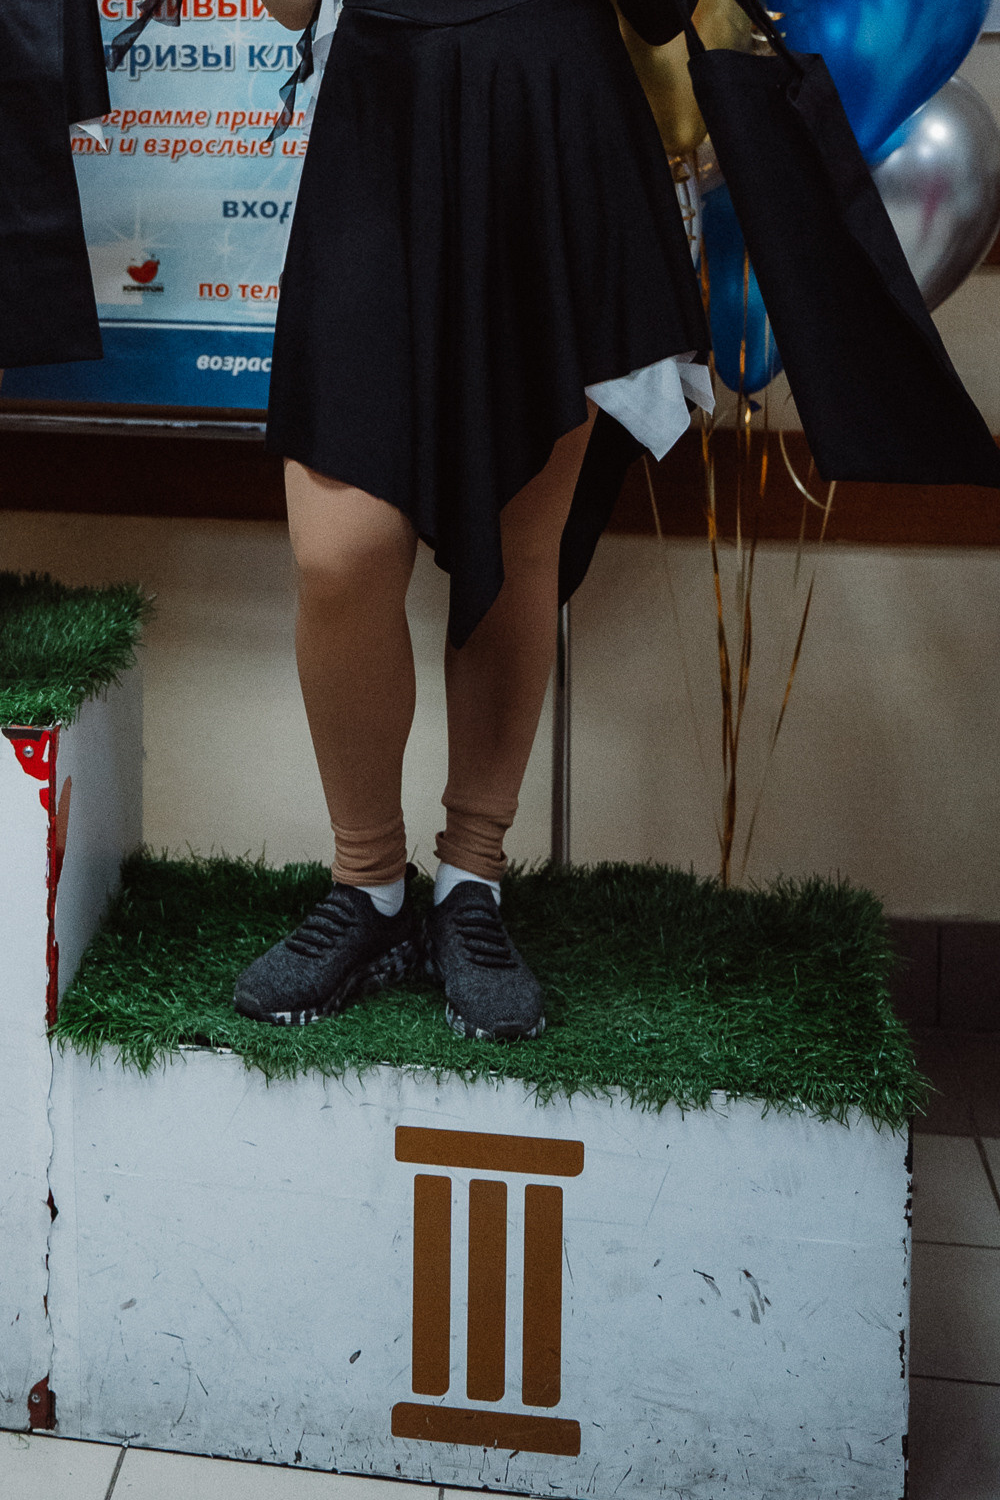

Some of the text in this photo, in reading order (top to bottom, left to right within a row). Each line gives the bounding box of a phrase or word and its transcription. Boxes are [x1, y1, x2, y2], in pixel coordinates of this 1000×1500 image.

[249, 44, 300, 67] кл
[143, 137, 272, 160] взрослые
[199, 283, 230, 298] по
